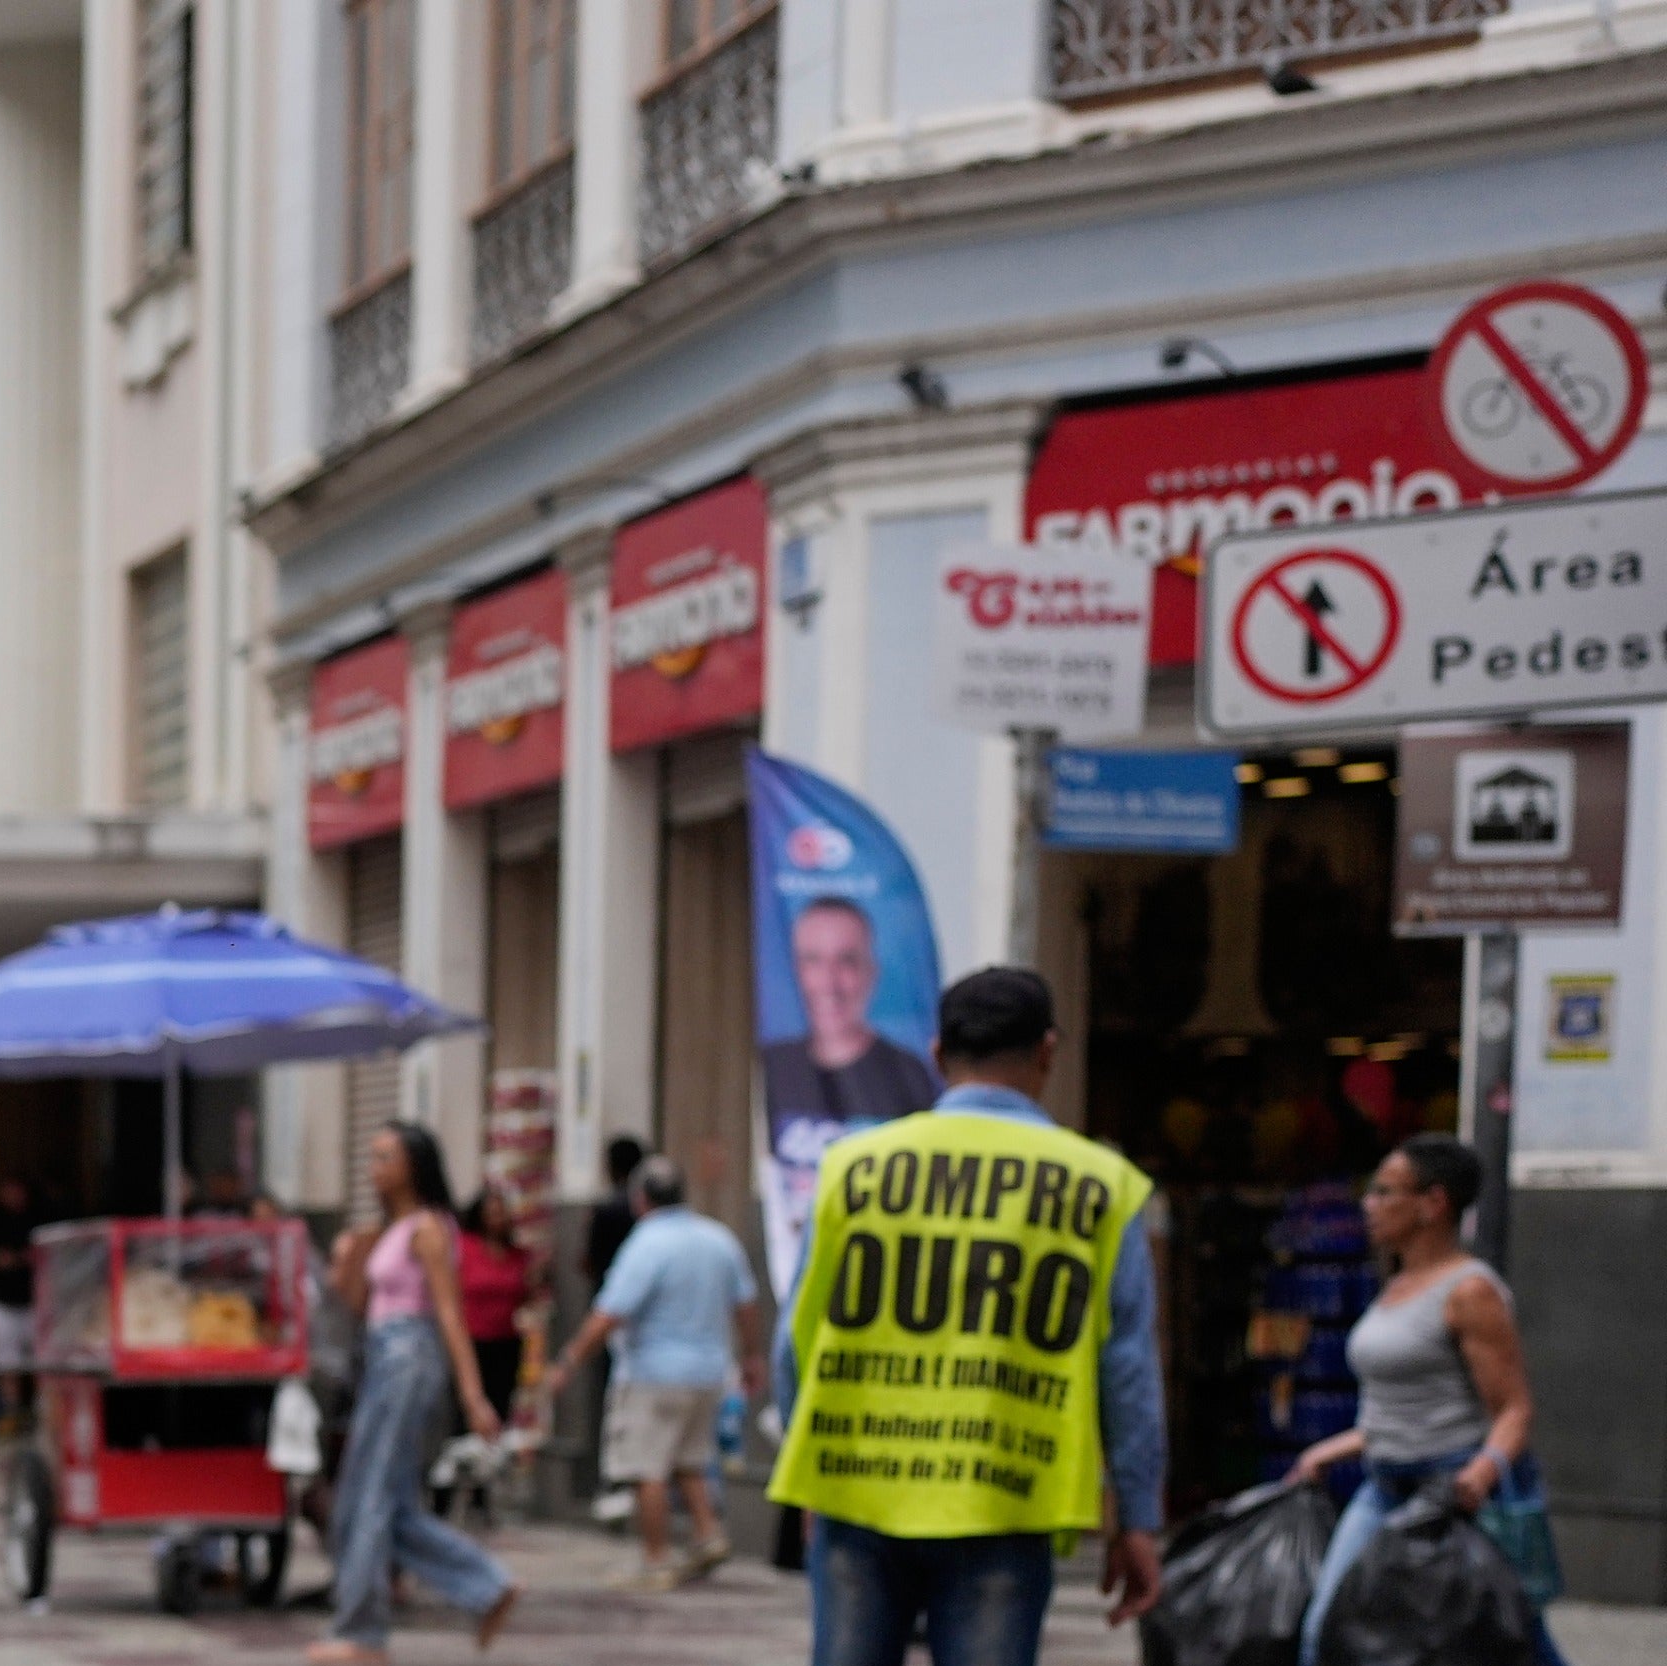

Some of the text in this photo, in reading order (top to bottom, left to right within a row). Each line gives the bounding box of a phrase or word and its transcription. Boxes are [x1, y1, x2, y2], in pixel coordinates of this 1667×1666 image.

[1470, 526, 1643, 597] Área
[844, 1150, 1110, 1240] COMPRO
[827, 1231, 1091, 1354] OURO
